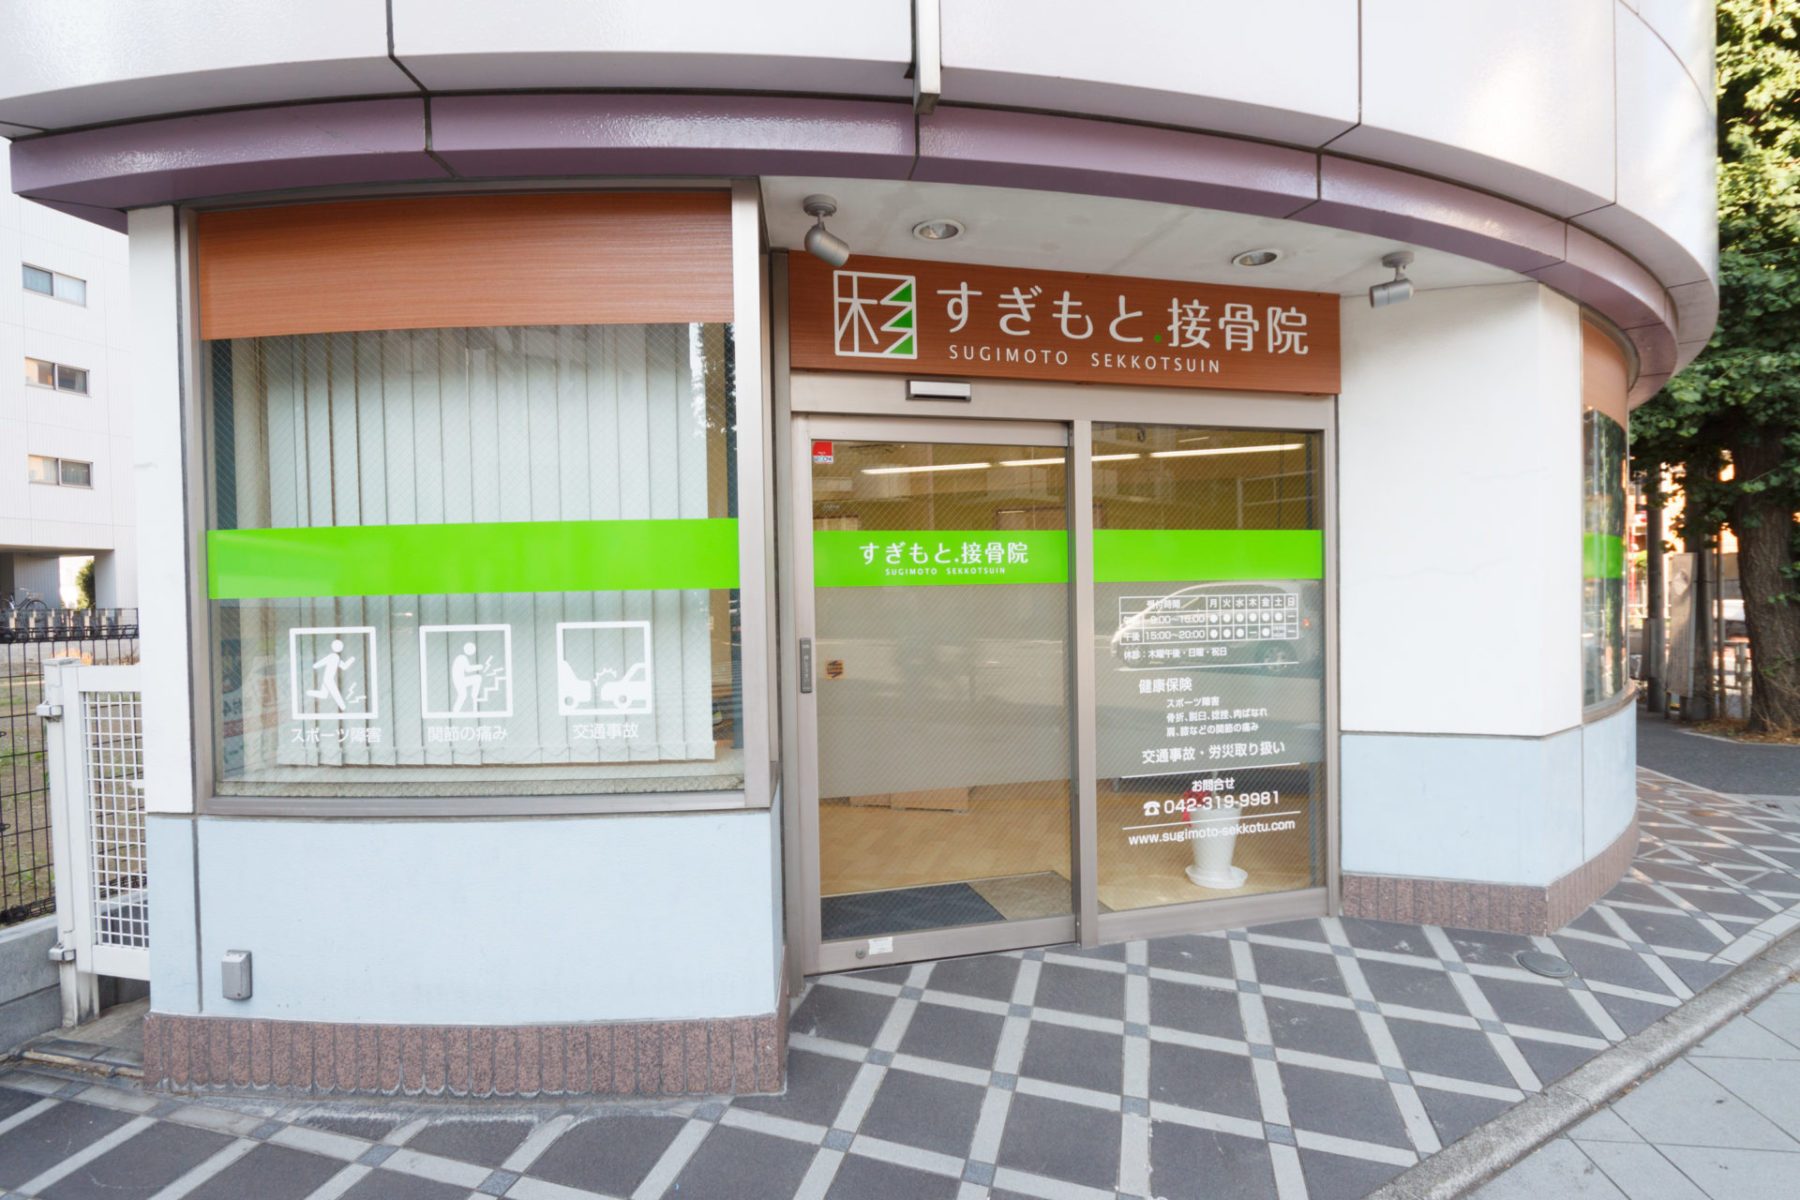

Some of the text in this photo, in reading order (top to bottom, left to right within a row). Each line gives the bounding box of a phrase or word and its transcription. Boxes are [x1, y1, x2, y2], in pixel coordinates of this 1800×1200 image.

[949, 344, 1221, 374] SUGIMOTO SEKKOTSUIN
[885, 567, 1006, 576] SUGIMOTO SEKKOTSUIN
[1210, 597, 1295, 608] 月 火 水 木 金 土 日
[1139, 677, 1192, 694] 健康保険
[1166, 696, 1220, 708] スポーツ障害
[290, 726, 383, 744] スポーツ障害
[427, 726, 508, 742] 関節の痛み
[572, 722, 640, 740] 交通事故
[1191, 777, 1235, 792] お問合せ
[1164, 791, 1279, 815] 042-319-9981
[1128, 820, 1296, 846] www.sugimoto-sekkotu.com
